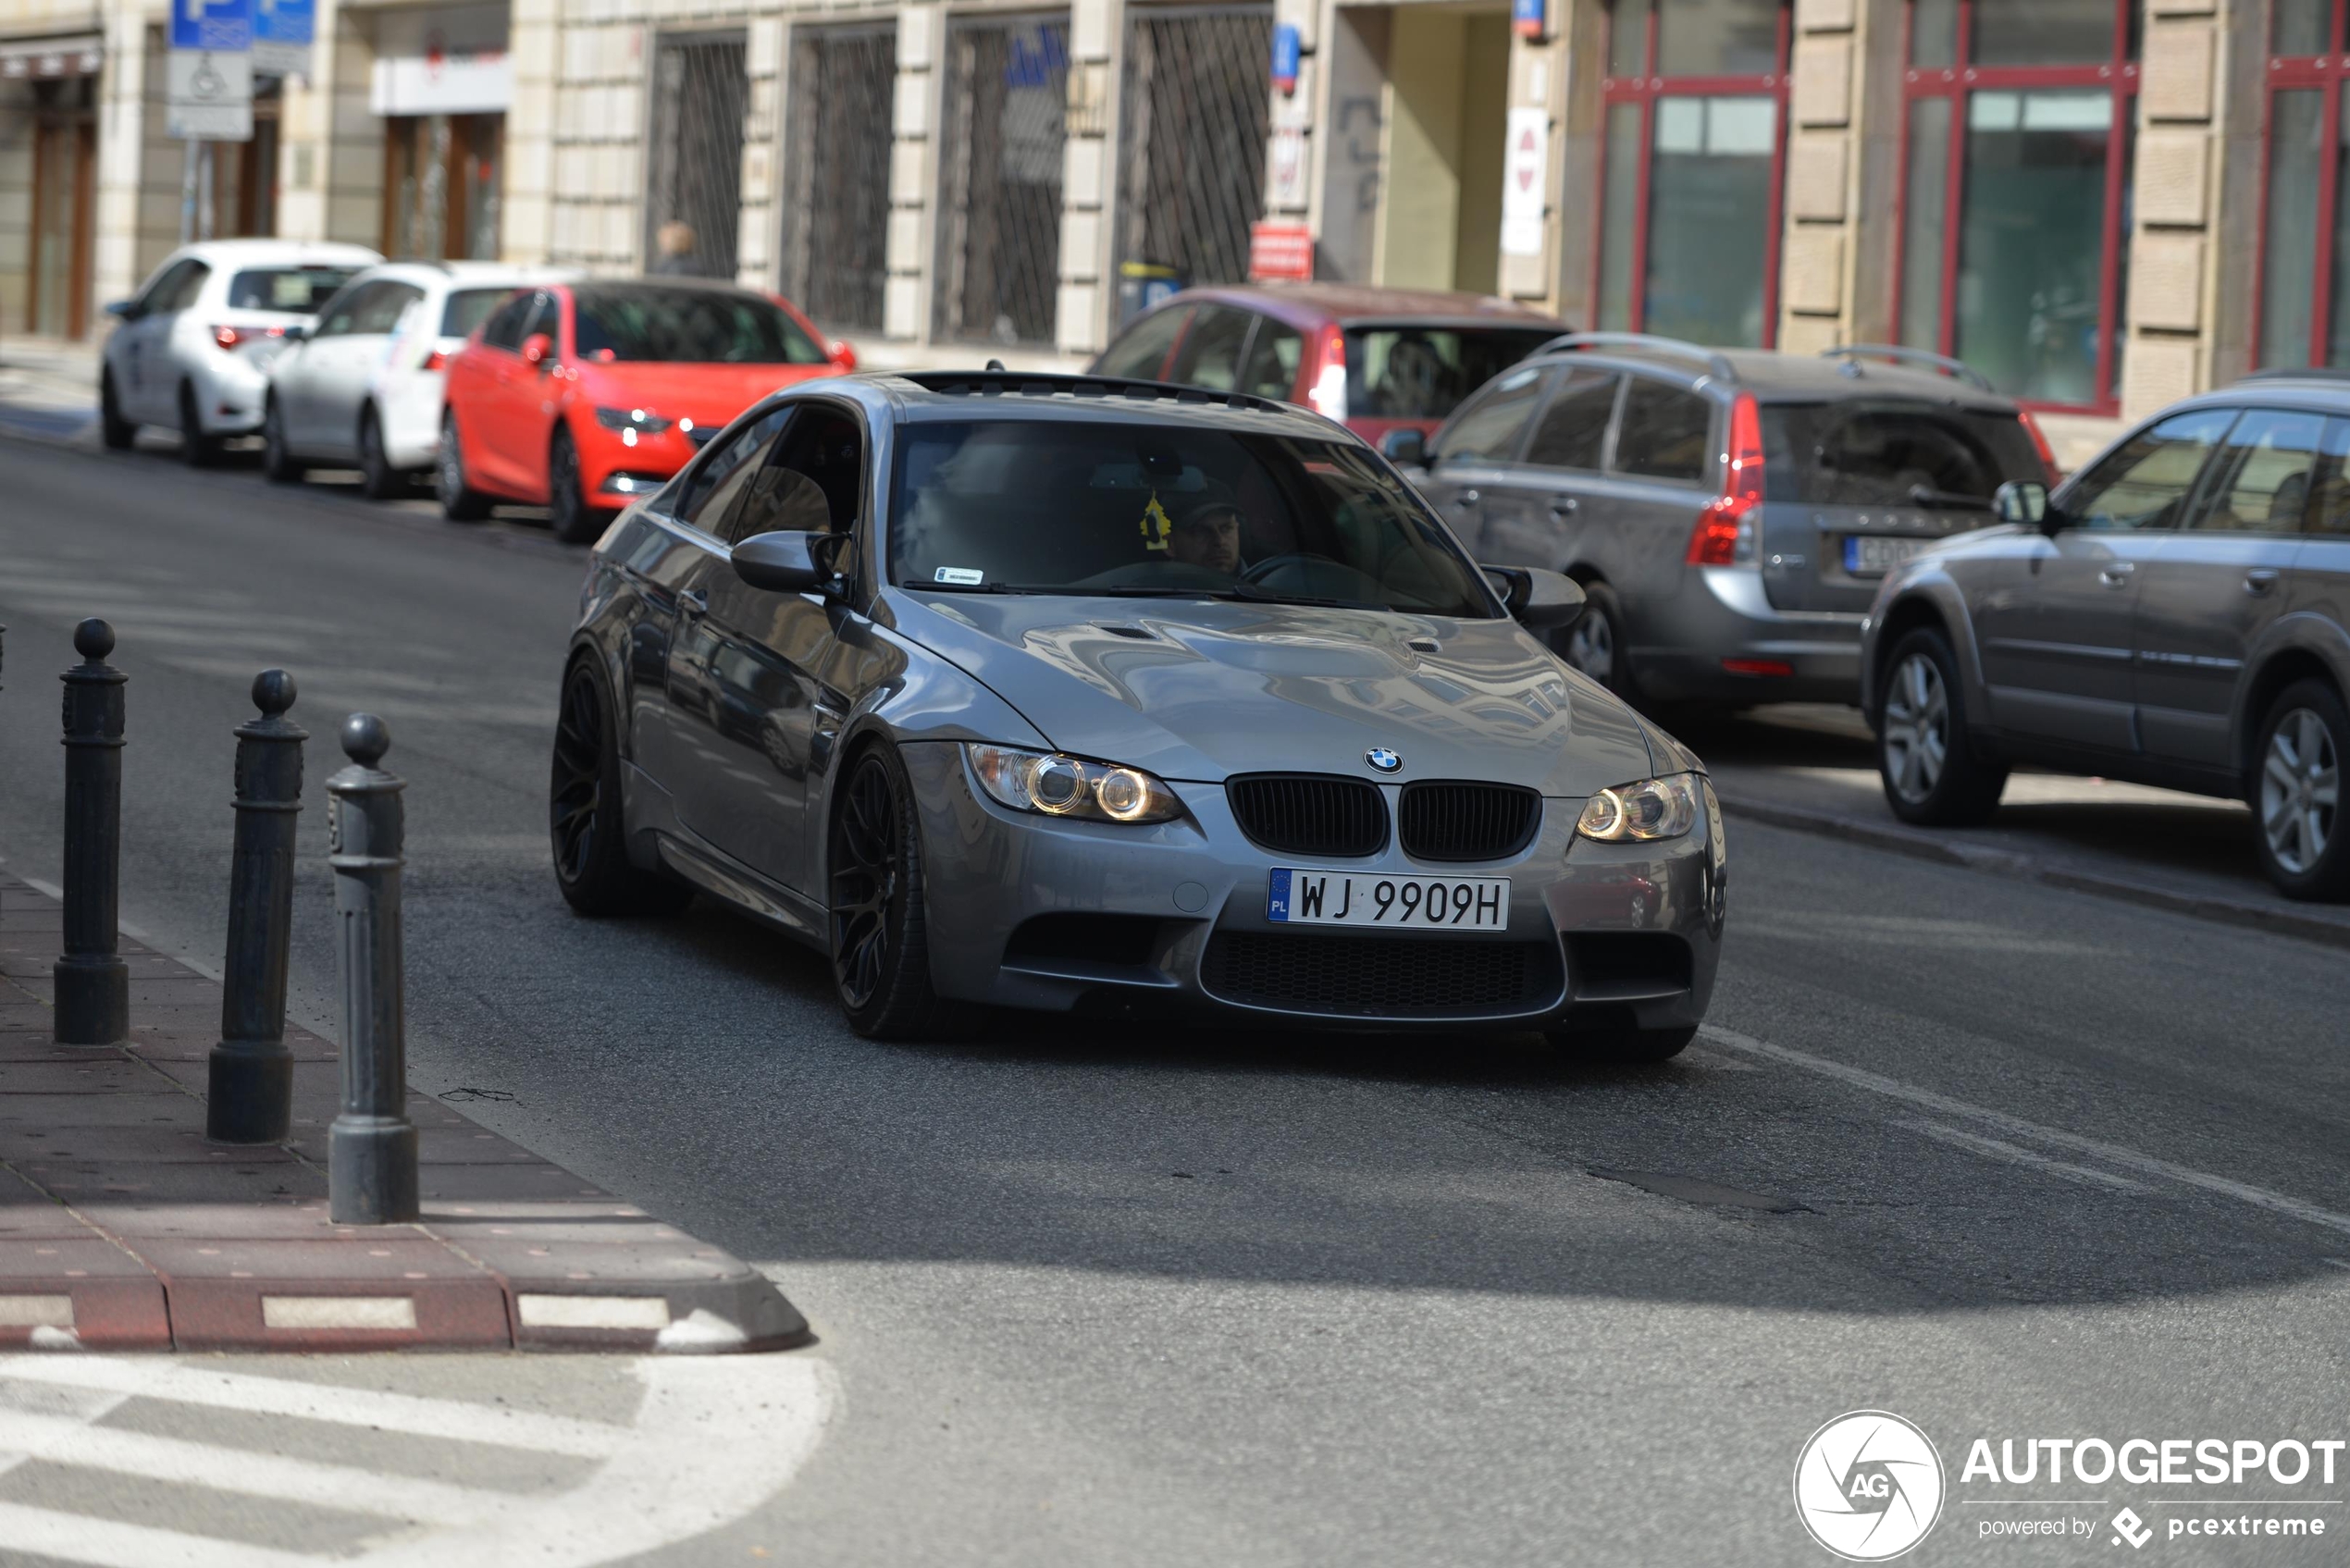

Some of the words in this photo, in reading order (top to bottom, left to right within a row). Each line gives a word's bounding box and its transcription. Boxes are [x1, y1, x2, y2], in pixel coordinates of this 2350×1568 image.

[1271, 900, 1287, 913] PL
[1301, 876, 1352, 919] WJ
[1372, 880, 1501, 925] 9909H
